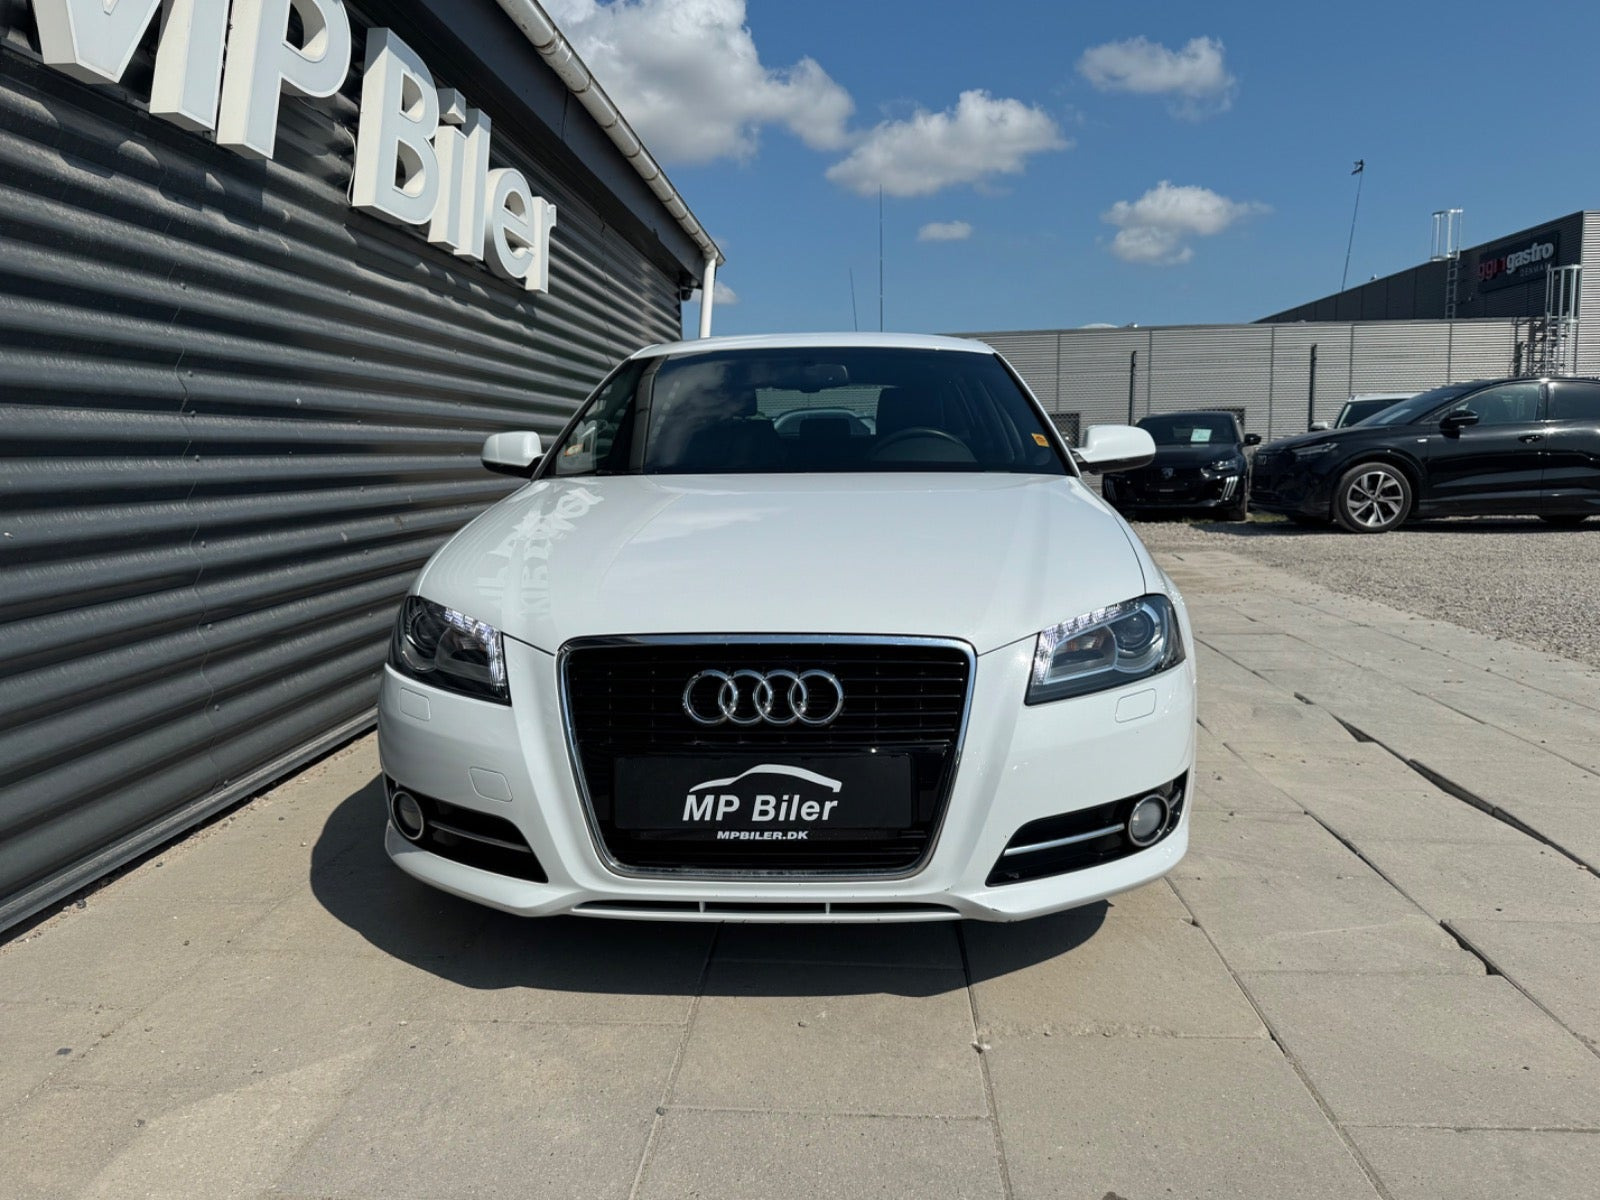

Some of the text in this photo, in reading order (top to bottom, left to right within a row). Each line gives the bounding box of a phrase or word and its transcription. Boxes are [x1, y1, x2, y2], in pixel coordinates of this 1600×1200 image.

[353, 27, 557, 294] Biler
[682, 794, 838, 822] MP Biler
[717, 830, 809, 841] MPBILER.DK
